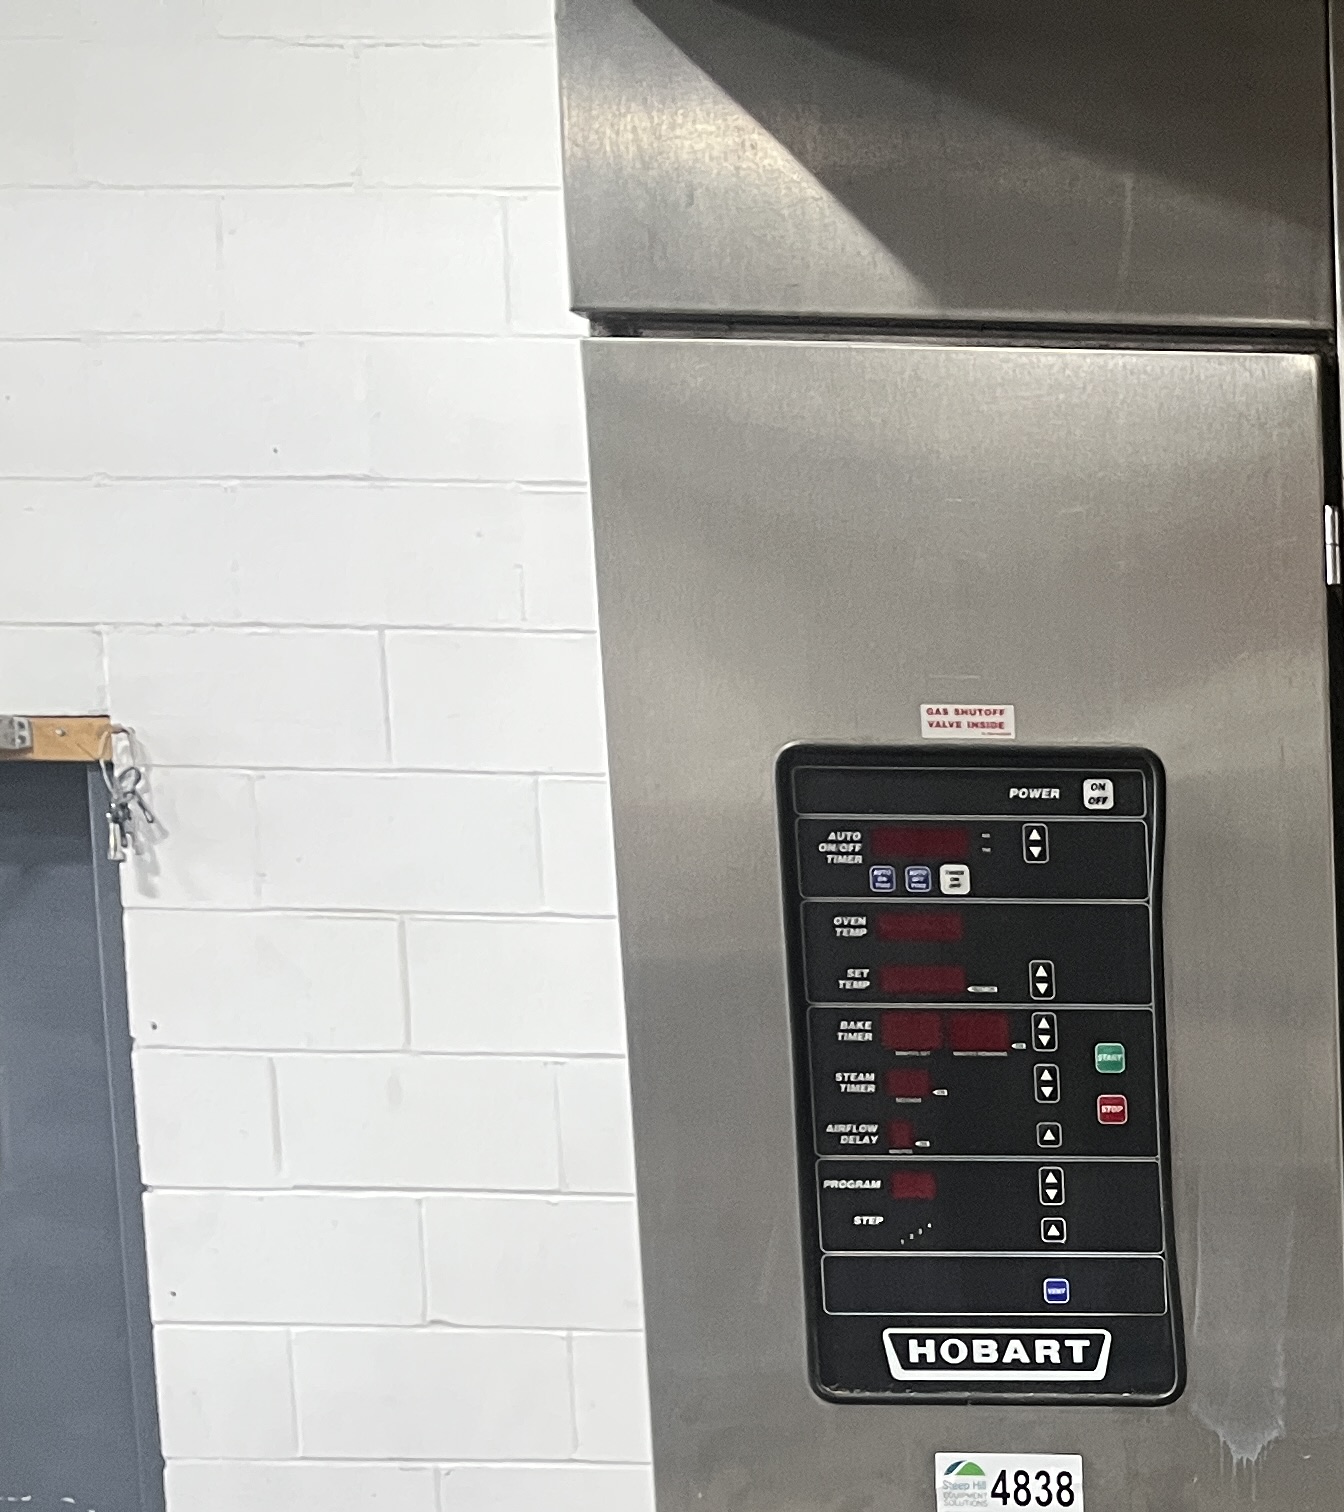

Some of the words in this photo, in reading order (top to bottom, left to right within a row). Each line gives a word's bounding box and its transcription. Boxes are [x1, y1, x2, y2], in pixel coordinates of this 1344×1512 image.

[926, 707, 949, 716] GAS
[953, 708, 1005, 716] SHUTOFF
[927, 720, 962, 729] VALVE
[967, 721, 1005, 729] INSIDE
[1090, 783, 1106, 791] ON
[1009, 787, 1060, 799] POWER
[1088, 796, 1108, 805] OFF
[827, 831, 862, 841] AUTO
[826, 854, 863, 864] TIMER
[833, 916, 867, 926] OVEN
[835, 927, 868, 937] TEMP
[846, 968, 870, 978] SET
[838, 979, 871, 989] TEMP
[840, 1020, 872, 1030] BAKE
[837, 1032, 873, 1042] TIMER
[1097, 1053, 1123, 1062] START
[835, 1072, 875, 1082] STEAM
[840, 1083, 876, 1093] TIMER
[1101, 1105, 1124, 1113] STOP
[826, 1124, 879, 1133] AIRFLOW
[840, 1135, 879, 1144] DELAY
[823, 1179, 882, 1189] PROGRAM
[853, 1215, 884, 1225] STEP
[908, 1338, 1091, 1365] HOBART
[990, 1469, 1075, 1507] 4838
